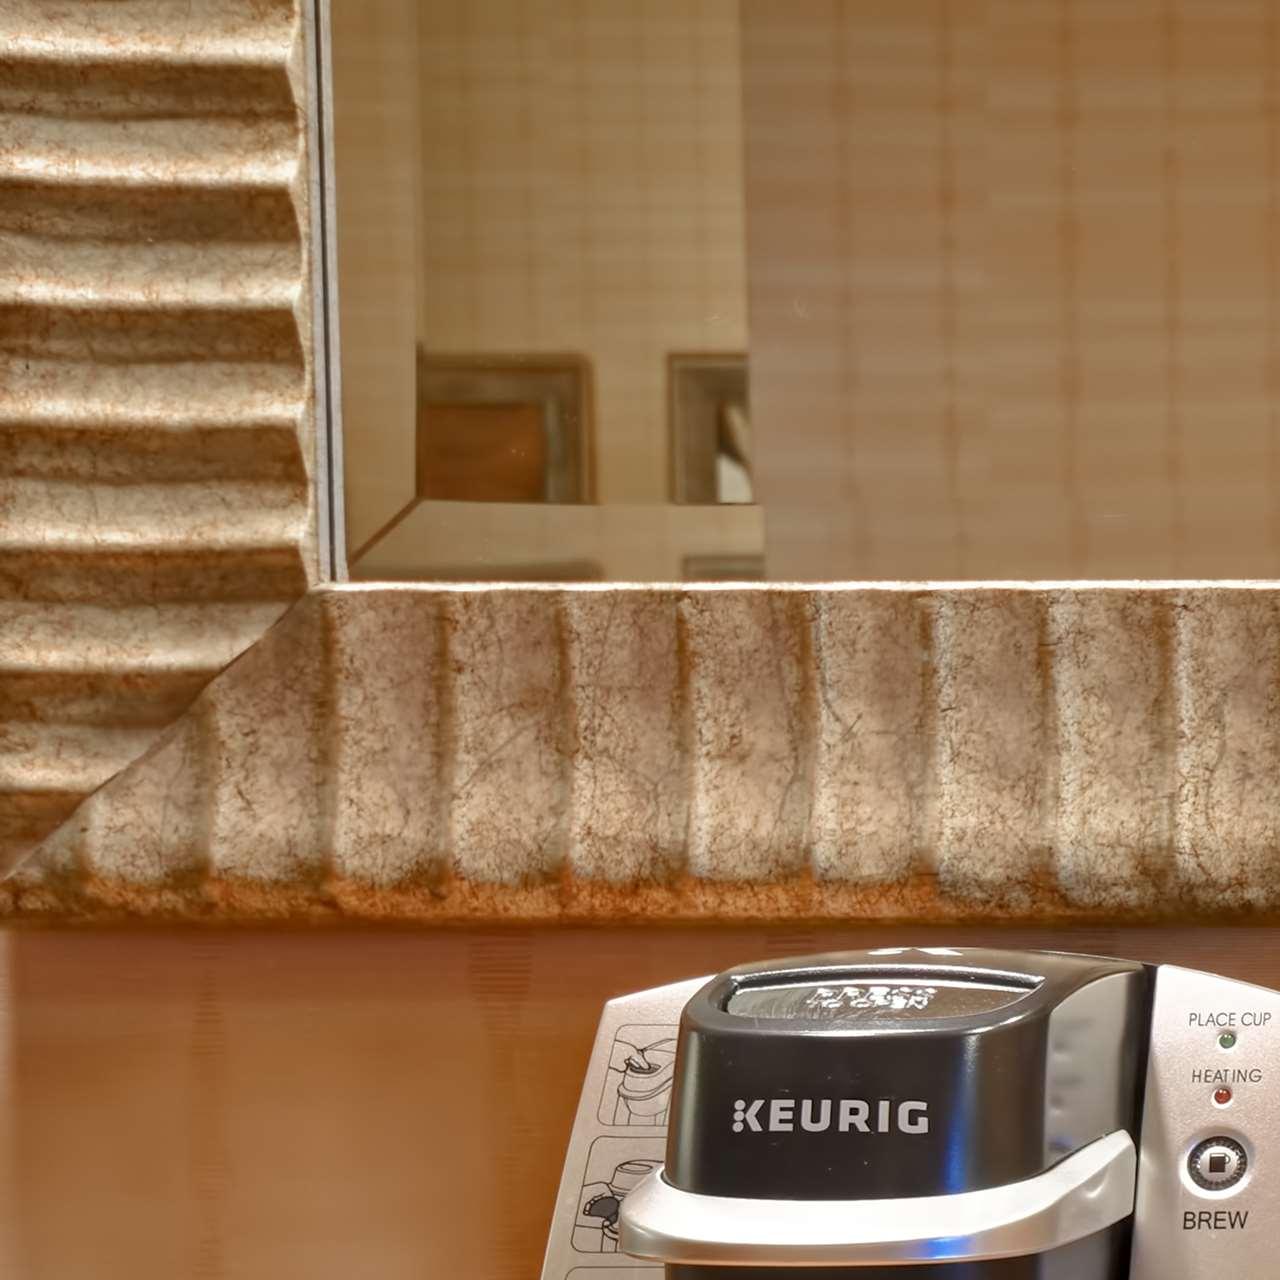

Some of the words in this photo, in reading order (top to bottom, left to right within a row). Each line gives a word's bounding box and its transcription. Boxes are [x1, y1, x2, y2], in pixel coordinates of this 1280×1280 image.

[1189, 1012, 1236, 1027] PLACE
[1241, 1012, 1272, 1027] CUP
[1191, 1068, 1263, 1083] HEATING
[732, 1099, 930, 1134] KEURIG
[1183, 1211, 1249, 1230] BREW
